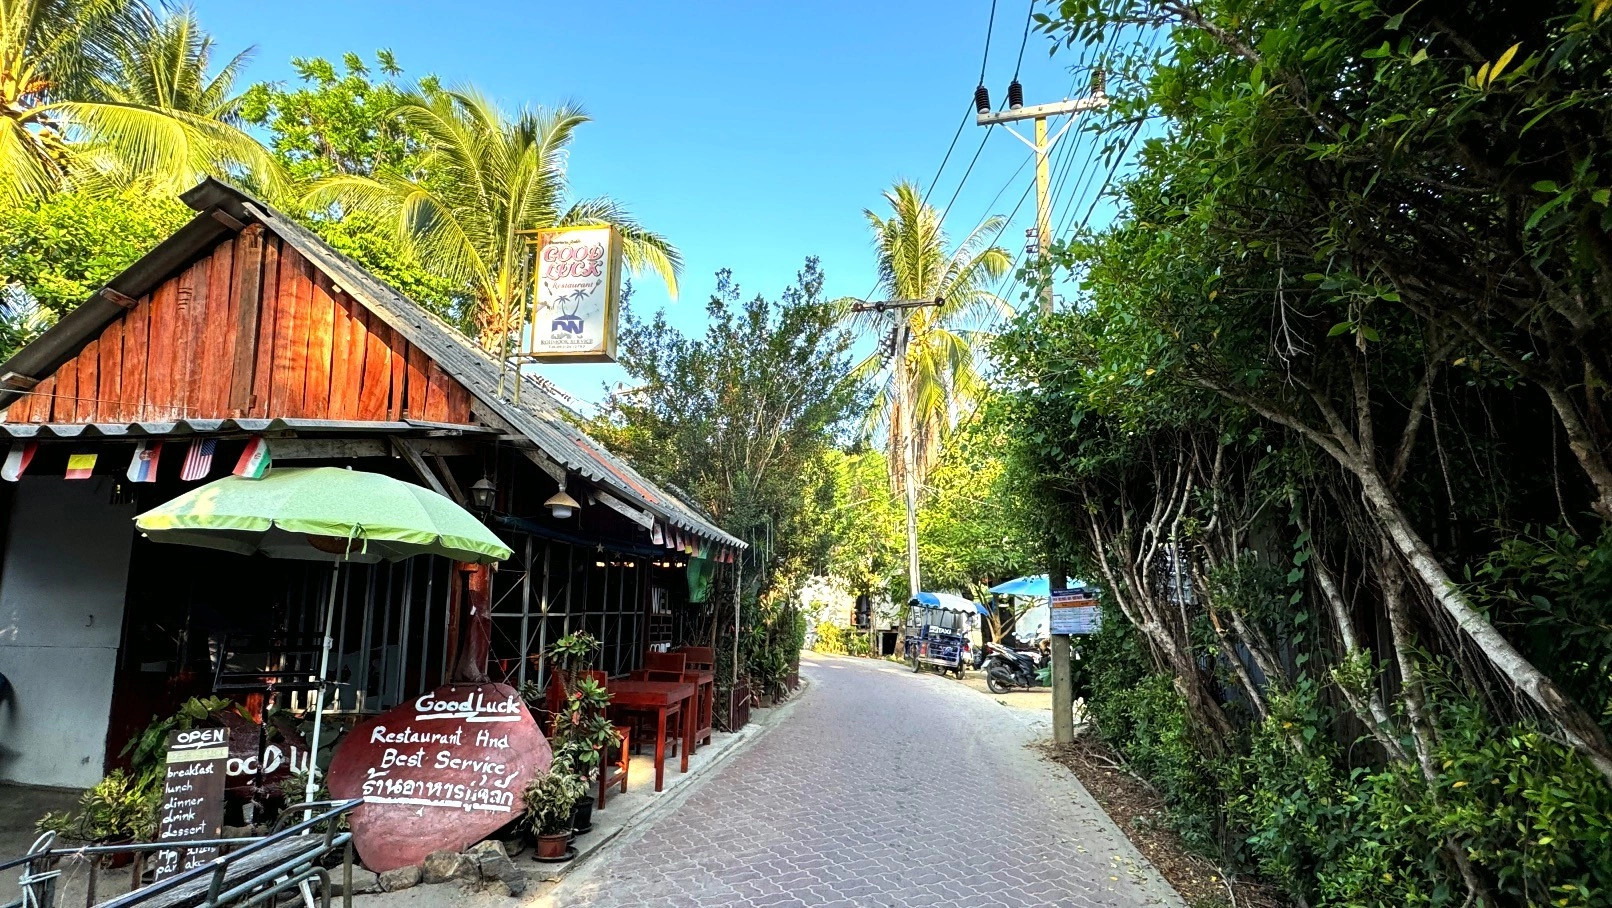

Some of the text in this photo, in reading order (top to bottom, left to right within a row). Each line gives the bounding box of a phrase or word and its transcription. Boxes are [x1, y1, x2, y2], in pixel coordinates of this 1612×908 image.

[543, 243, 605, 262] GOOD
[542, 260, 604, 281] LUCK
[415, 690, 521, 714] Good Luck
[177, 729, 224, 743] OPEN
[370, 725, 462, 746] Restaurant
[167, 762, 214, 778] breakfast
[380, 748, 506, 775] Best Service
[165, 780, 192, 793] lunch
[164, 796, 204, 810] dinner
[162, 807, 196, 824] drink
[161, 820, 207, 838] dessert
